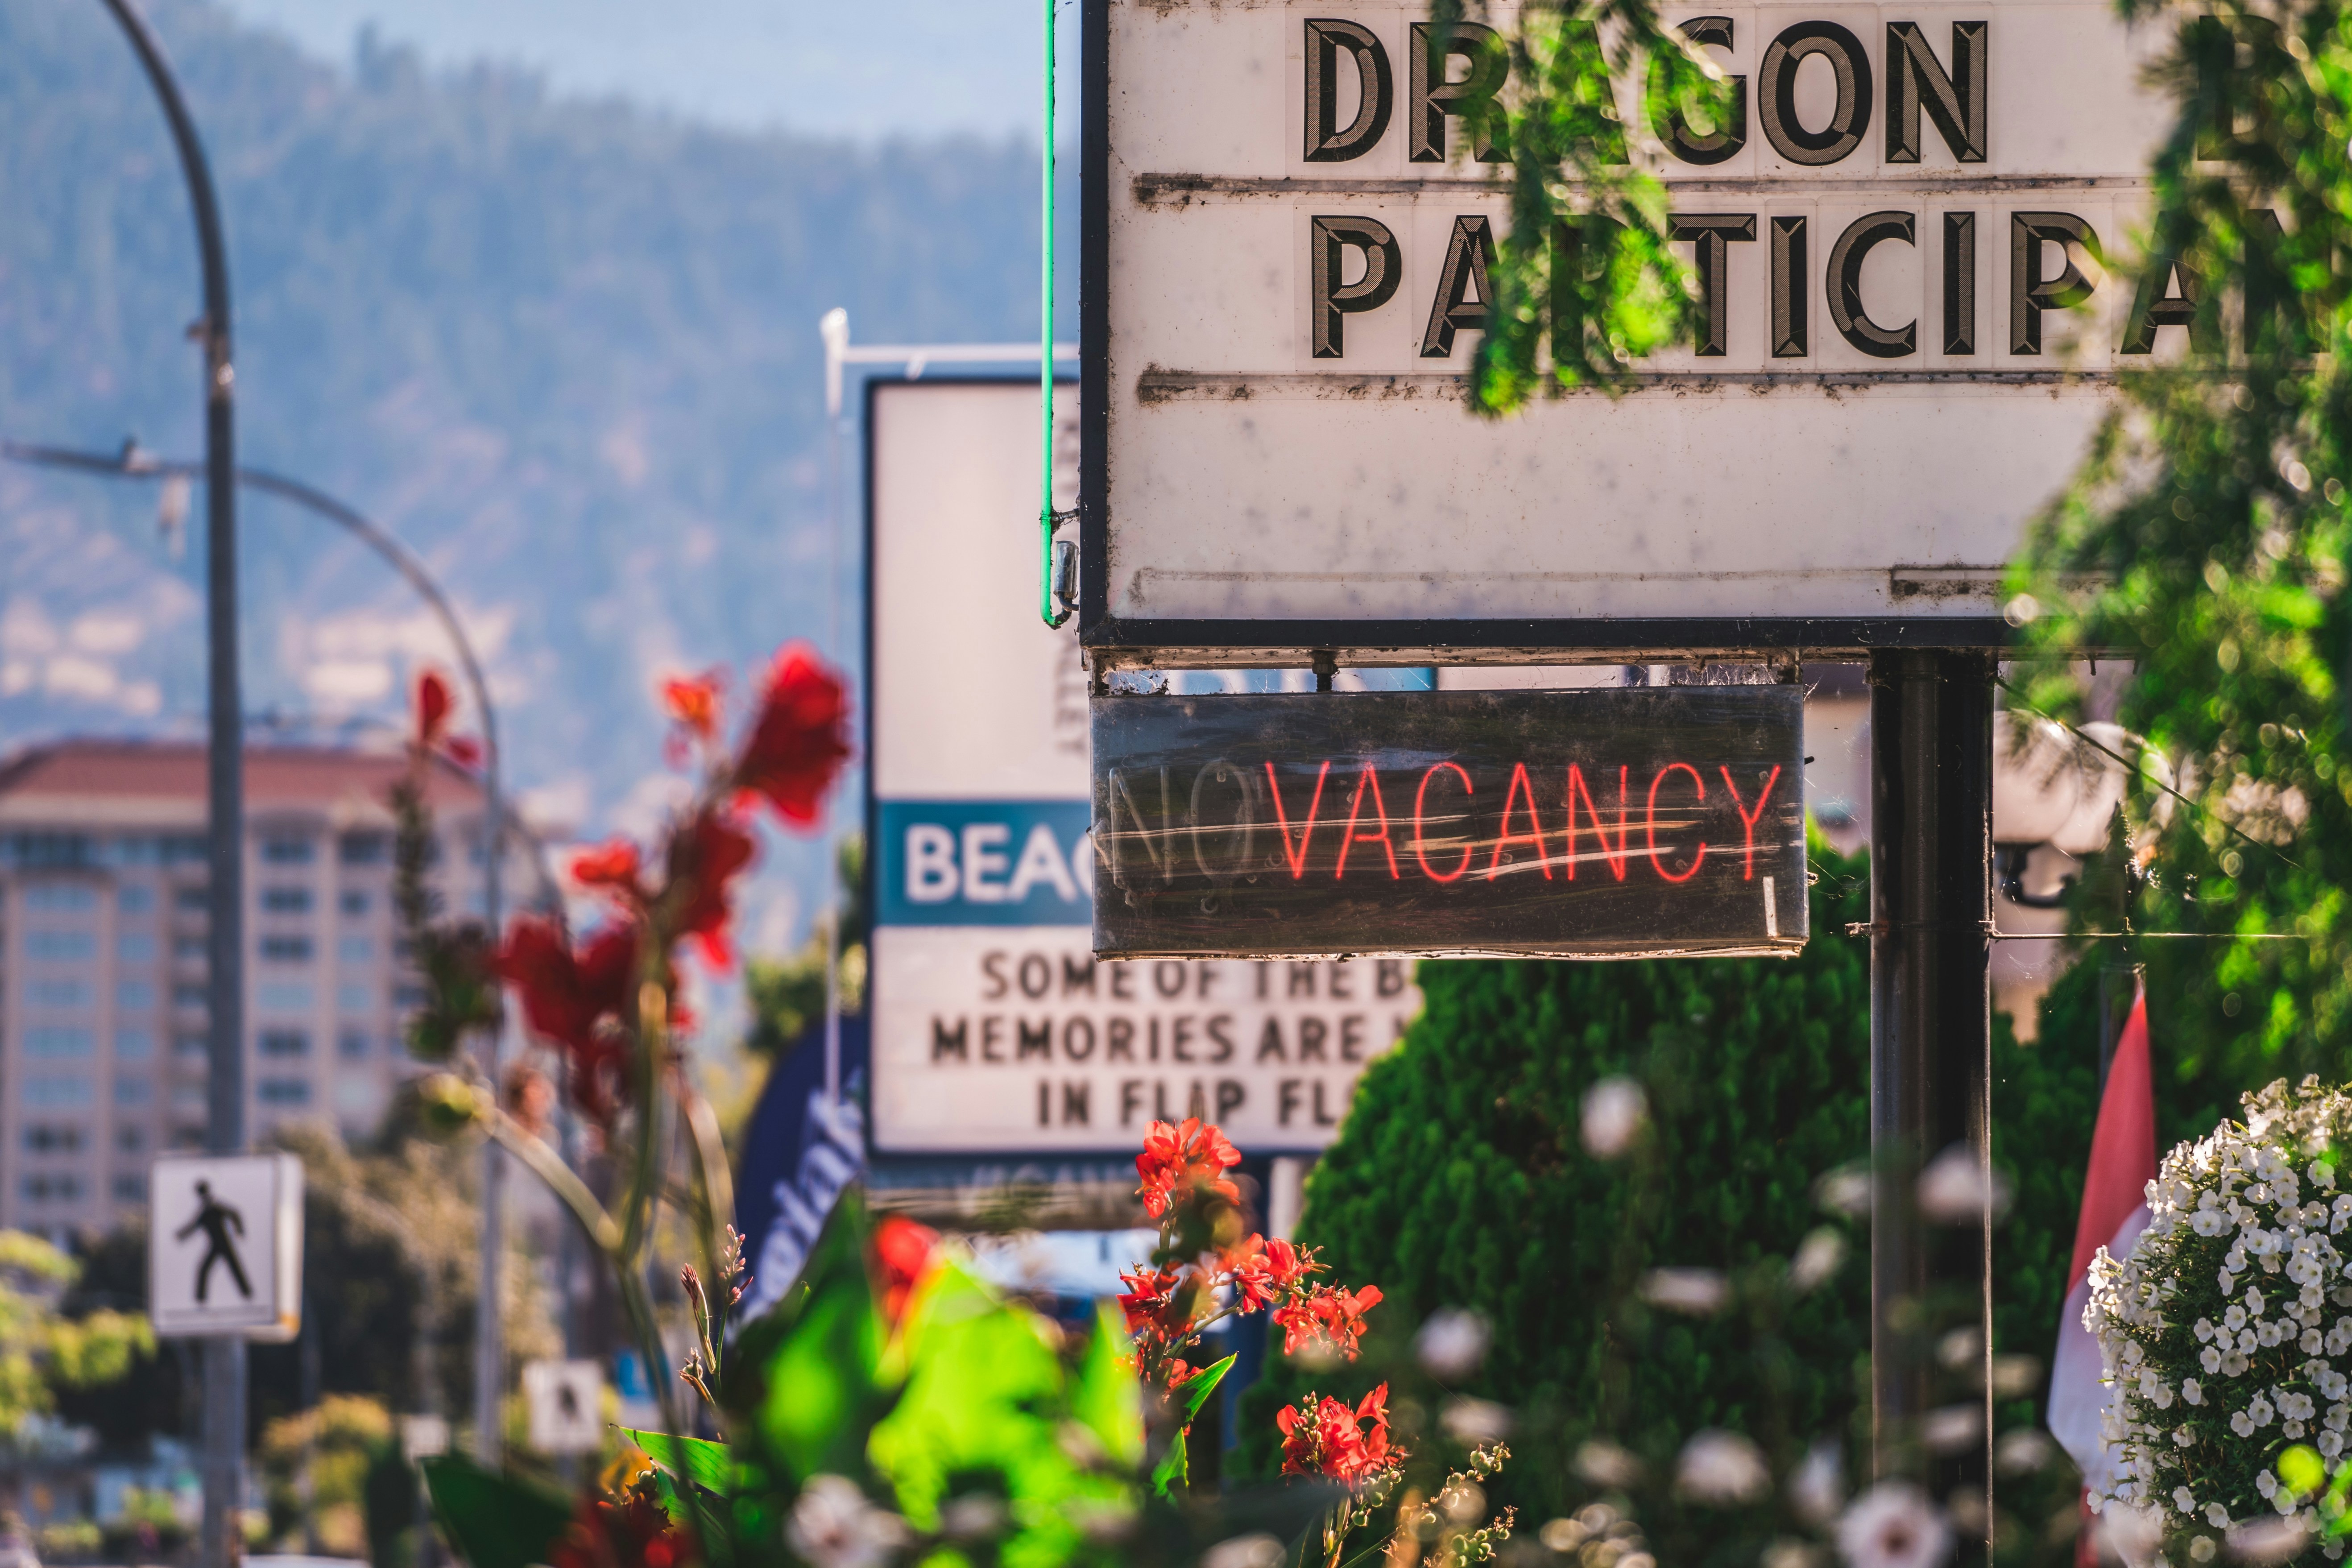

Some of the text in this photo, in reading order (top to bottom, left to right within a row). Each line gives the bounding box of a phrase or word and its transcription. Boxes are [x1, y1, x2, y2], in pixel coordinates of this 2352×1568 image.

[1303, 16, 1988, 166] DRAGON
[1109, 759, 1781, 886] NO VACANCY
[981, 950, 1134, 1000] SOME
[1153, 960, 1221, 1000] OF
[930, 1014, 1234, 1063] MEMORIES
[1256, 1014, 1364, 1063] ARE
[1037, 1079, 1089, 1127] IN
[1278, 1079, 1354, 1125] FL
